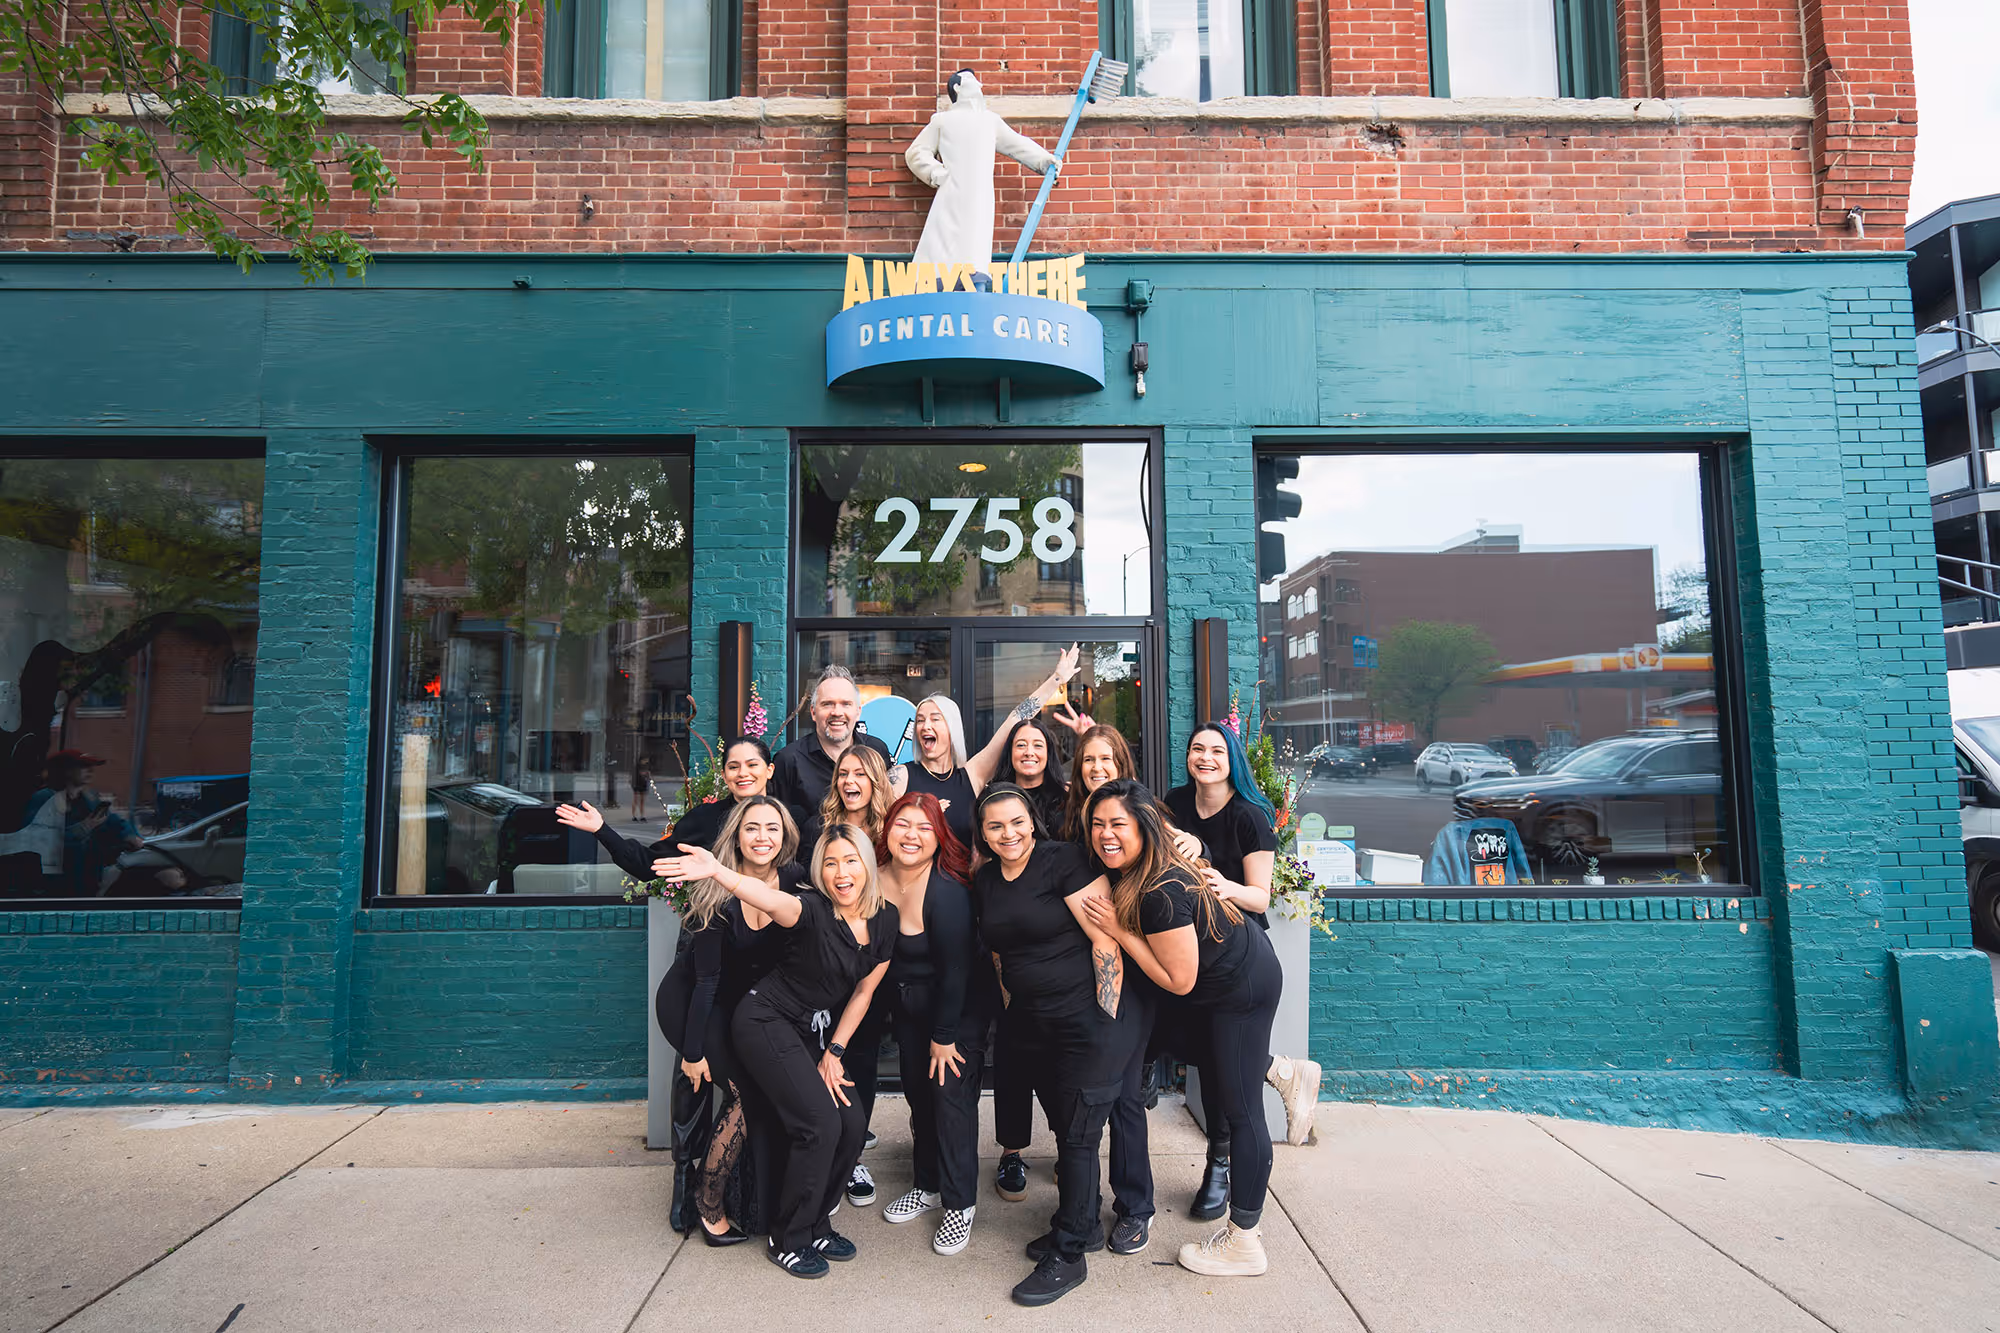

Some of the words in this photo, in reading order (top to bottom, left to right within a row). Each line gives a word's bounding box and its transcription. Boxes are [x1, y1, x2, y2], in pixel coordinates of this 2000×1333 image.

[842, 253, 978, 312] ALWAYS
[988, 252, 1087, 312] THERE
[859, 313, 974, 347] DENTAL
[993, 315, 1070, 347] CARE
[874, 496, 1077, 564] 2758
